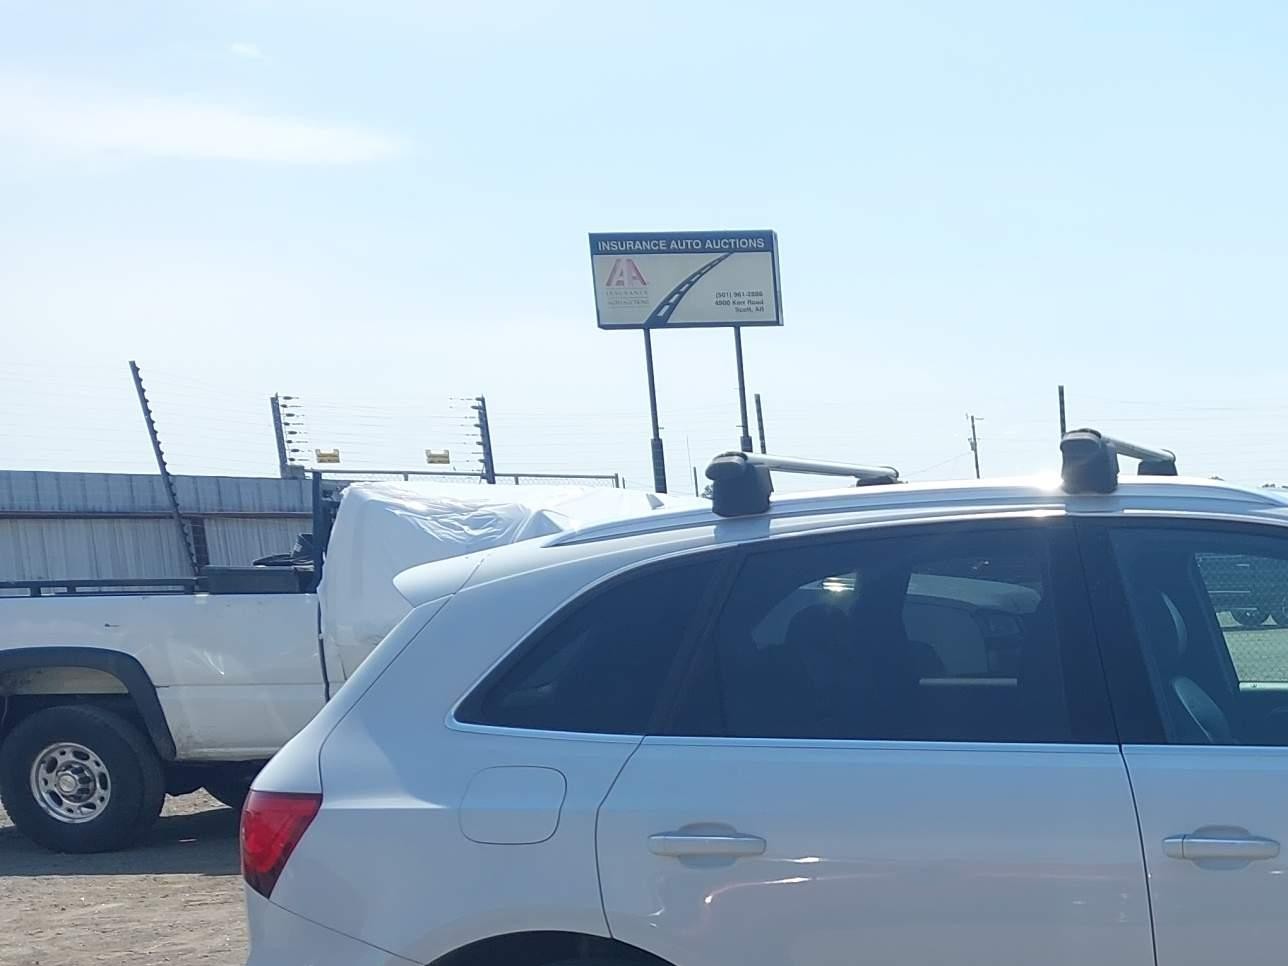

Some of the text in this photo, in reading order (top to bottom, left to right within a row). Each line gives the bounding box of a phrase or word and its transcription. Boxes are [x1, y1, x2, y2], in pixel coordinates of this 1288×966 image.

[598, 238, 765, 251] INSURANCE AUTO AUCTIONS
